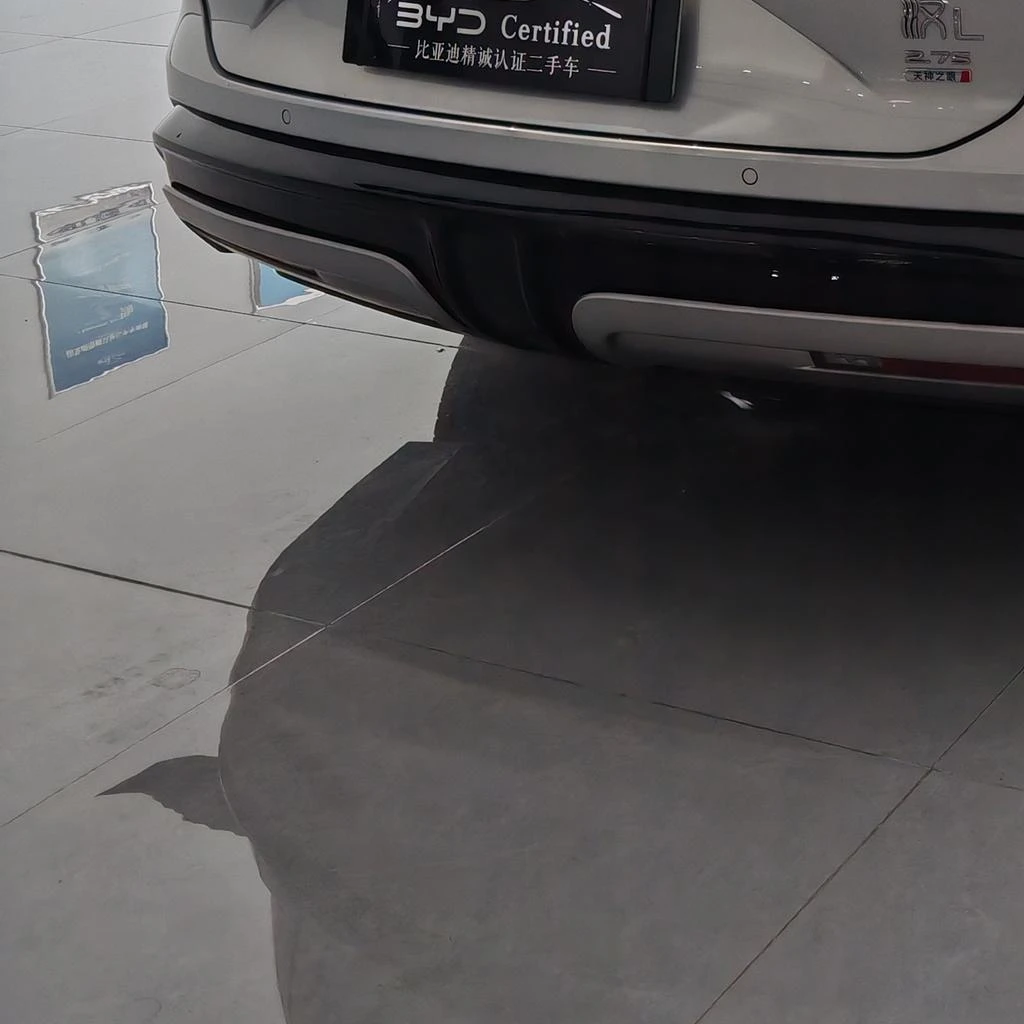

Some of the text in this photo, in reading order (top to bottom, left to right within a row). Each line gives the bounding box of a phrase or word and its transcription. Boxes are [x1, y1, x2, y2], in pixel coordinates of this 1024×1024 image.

[396, 1, 611, 50] BYD Certified
[415, 39, 580, 79] 比亚迪精诚认证二手车
